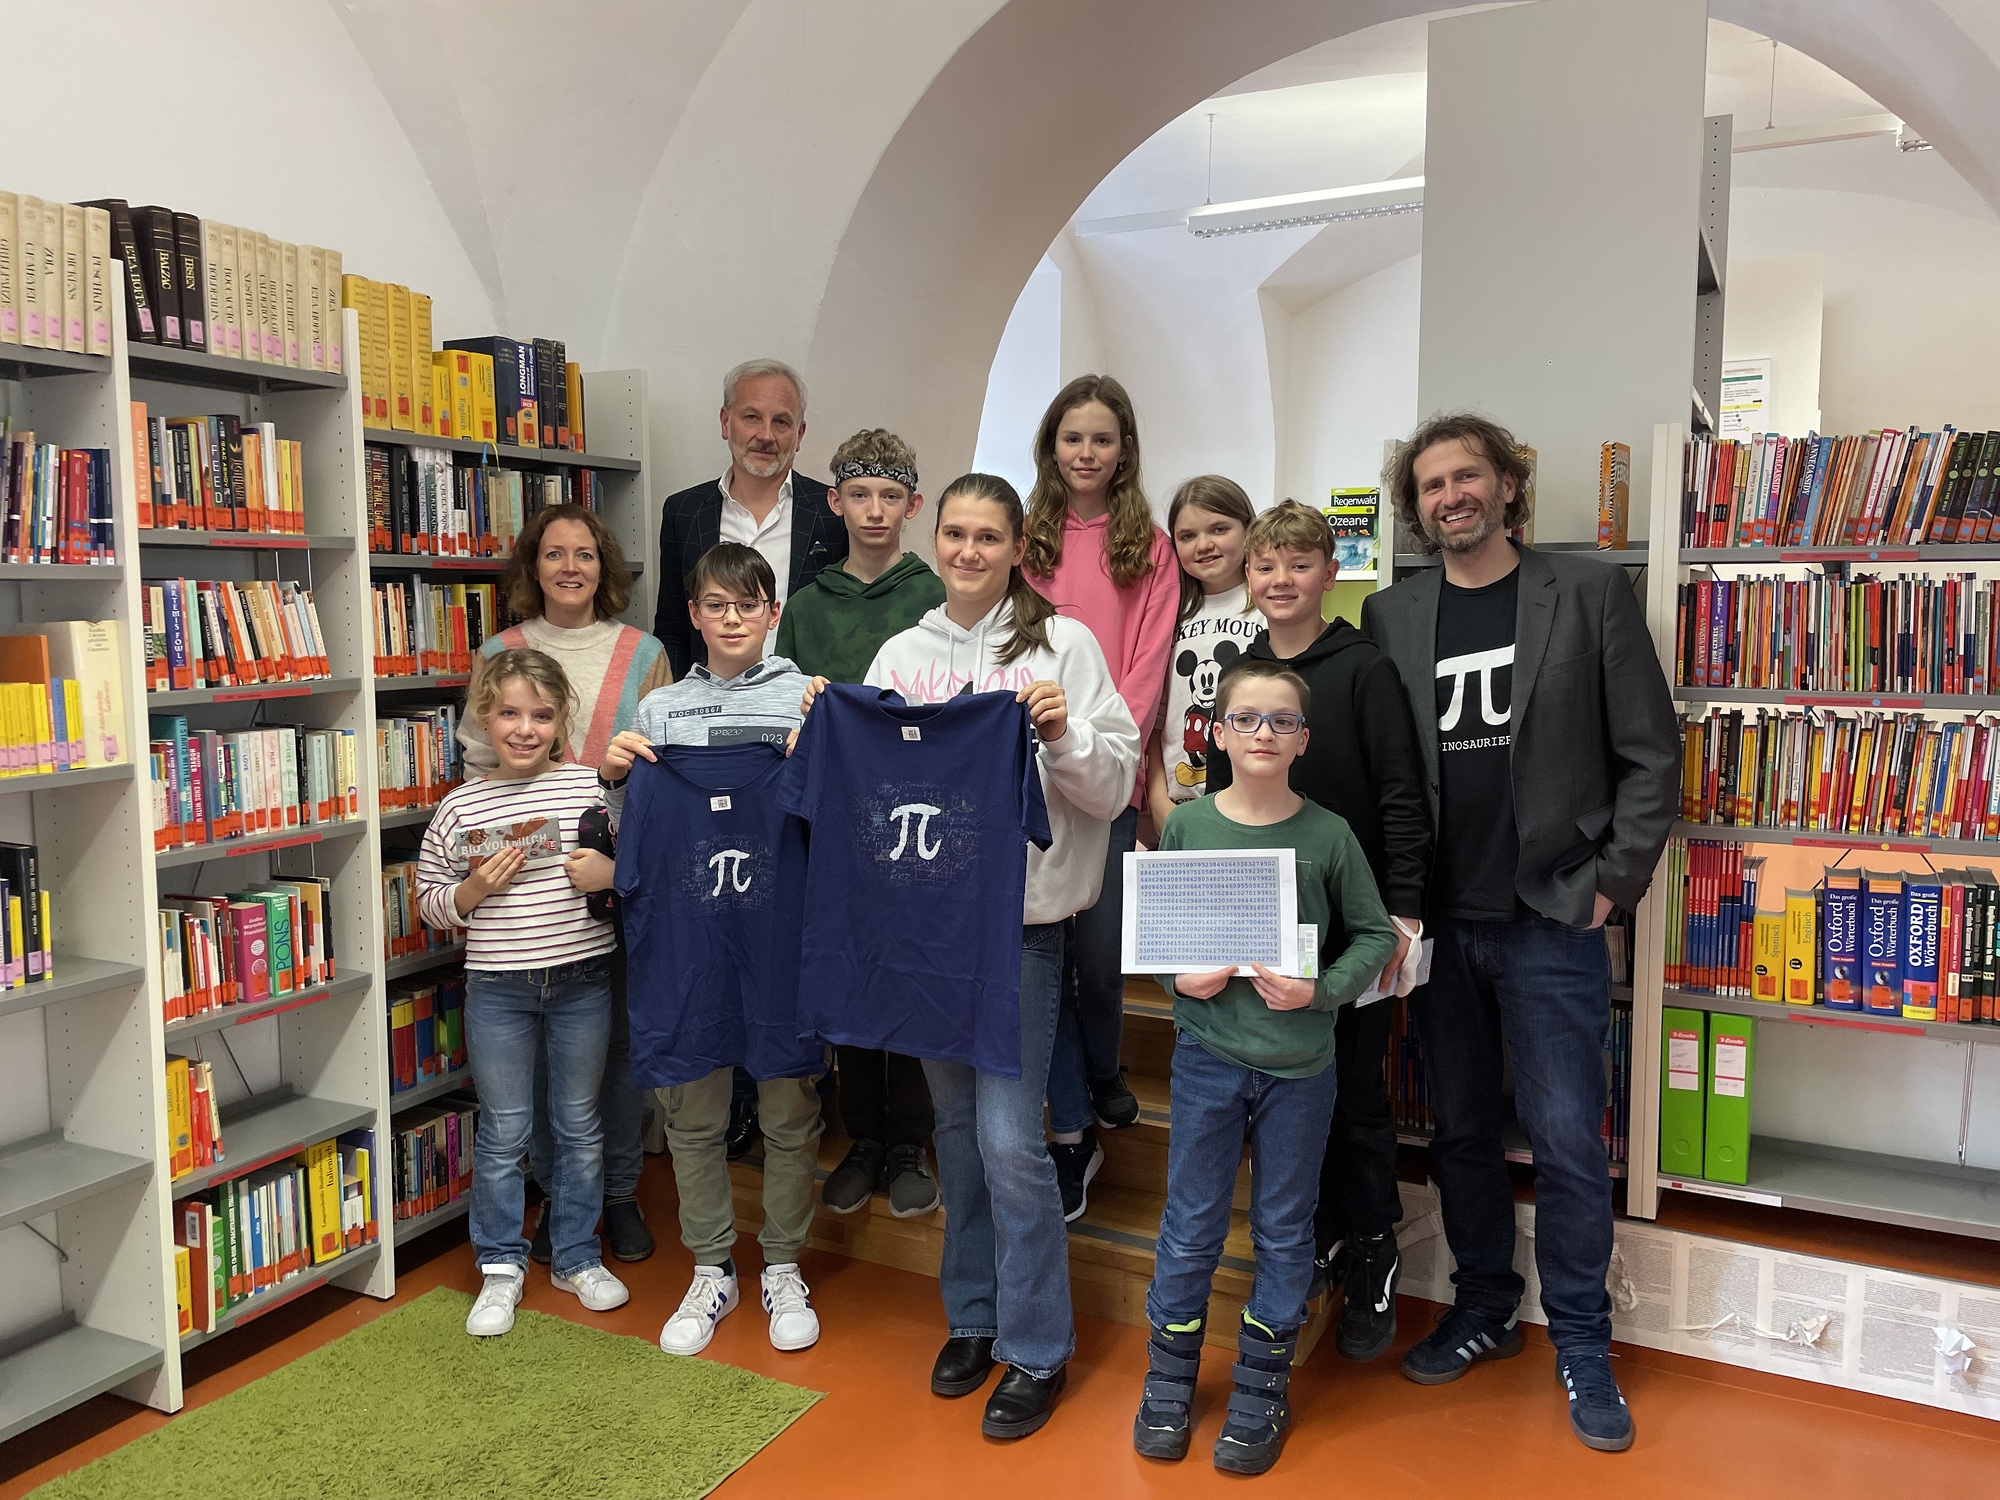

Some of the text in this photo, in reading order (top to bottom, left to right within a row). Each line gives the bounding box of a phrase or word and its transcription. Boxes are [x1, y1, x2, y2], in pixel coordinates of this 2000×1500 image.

[43, 247, 54, 275] ZOLA
[159, 252, 172, 291] BALZAC
[184, 257, 196, 291] IBSEN
[66, 253, 77, 300] DICKENS
[91, 256, 103, 313] PUSCHKIN
[224, 268, 234, 324] BOCCACCIO
[245, 273, 254, 318] NESTROY
[259, 274, 269, 325] CALDERON
[328, 294, 336, 313] ZOLA
[458, 398, 467, 430] Englisch
[137, 431, 147, 490] WHAT IF IT'S
[222, 462, 230, 488] ASIMOV
[374, 468, 382, 482] THE
[375, 485, 384, 506] FINAL
[1333, 496, 1376, 506] Regenwald
[1328, 516, 1368, 526] Ozeane
[173, 632, 183, 659] FOWL
[205, 626, 213, 650] CORMIER
[180, 729, 189, 756] STARTS
[1721, 731, 1729, 756] DARKEST
[182, 757, 190, 777] WITH
[189, 748, 198, 774] HOOVER
[253, 752, 261, 773] GAMES
[184, 778, 191, 788] US
[193, 786, 202, 802] ENDS
[195, 802, 203, 818] WITH
[220, 790, 228, 806] About
[461, 833, 547, 856] BIO VOLLMILCH
[1803, 911, 1814, 945] Englisch
[1828, 901, 1843, 952] Oxford
[1846, 903, 1857, 953] Wörterbuch
[1965, 907, 1974, 927] English
[1987, 905, 1996, 925] English
[274, 919, 291, 971] PONS
[1771, 924, 1782, 958] Spanisch
[1868, 906, 1883, 957] Oxford
[1887, 907, 1898, 958] Wörterbuch
[1909, 904, 1923, 967] OXFORD
[1924, 905, 1938, 970] Wörterbuch
[1965, 927, 1973, 950] Grammar
[1986, 925, 1994, 948] Grammar
[1985, 955, 1993, 966] Use
[325, 1145, 335, 1188] Italienisch
